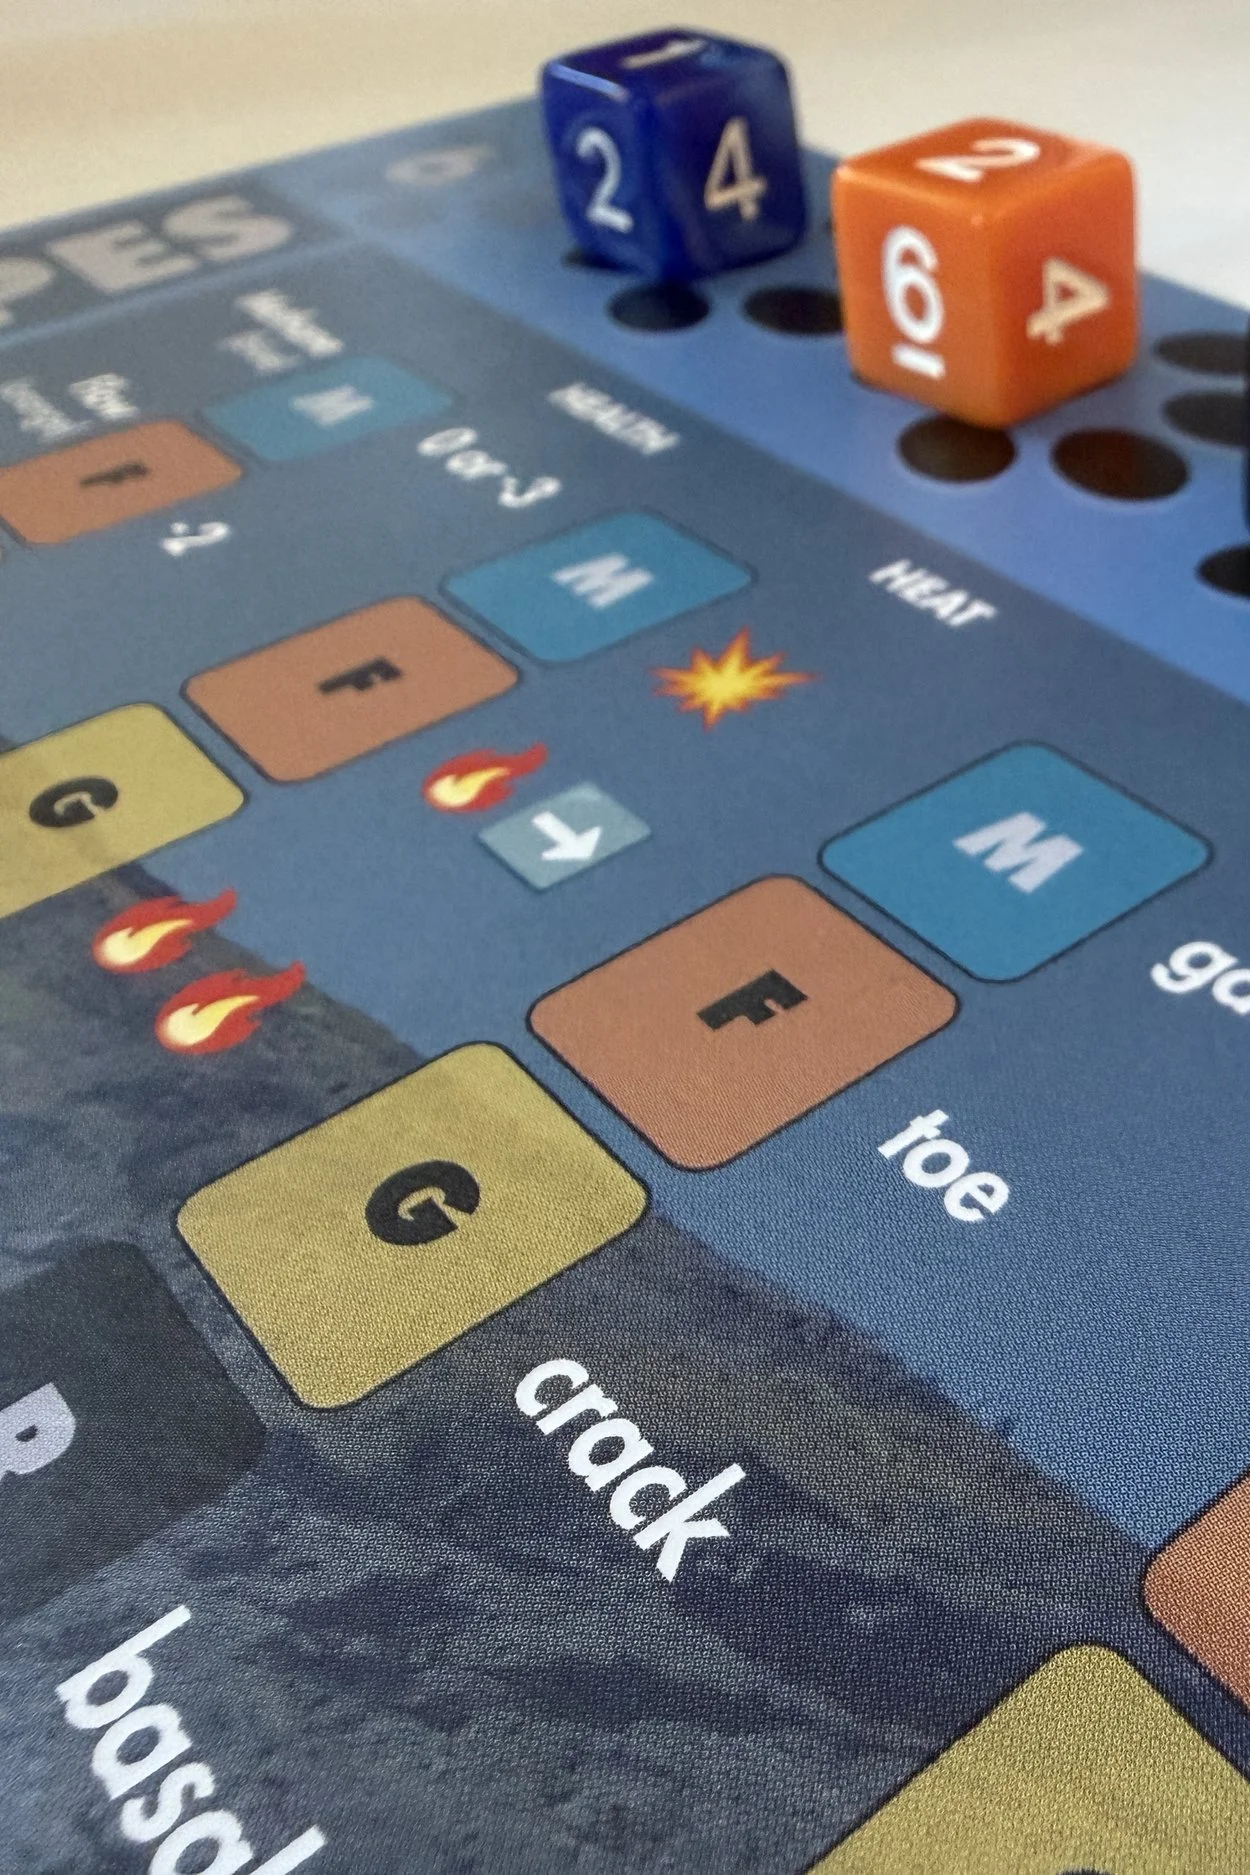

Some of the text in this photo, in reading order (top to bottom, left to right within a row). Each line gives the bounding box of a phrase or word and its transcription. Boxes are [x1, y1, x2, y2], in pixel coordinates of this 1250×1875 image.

[577, 127, 634, 233] 2
[704, 117, 768, 222] 4
[918, 138, 1042, 184] 2
[882, 225, 946, 345] 6
[1027, 258, 1111, 345] 4
[553, 554, 654, 609] M
[870, 560, 997, 628] HEAT
[318, 657, 403, 696] F
[28, 776, 120, 830] G
[953, 811, 1084, 895] M
[696, 969, 809, 1031] F
[364, 1159, 482, 1249] G
[877, 1109, 1011, 1223] toe
[514, 1357, 748, 1583] crack
